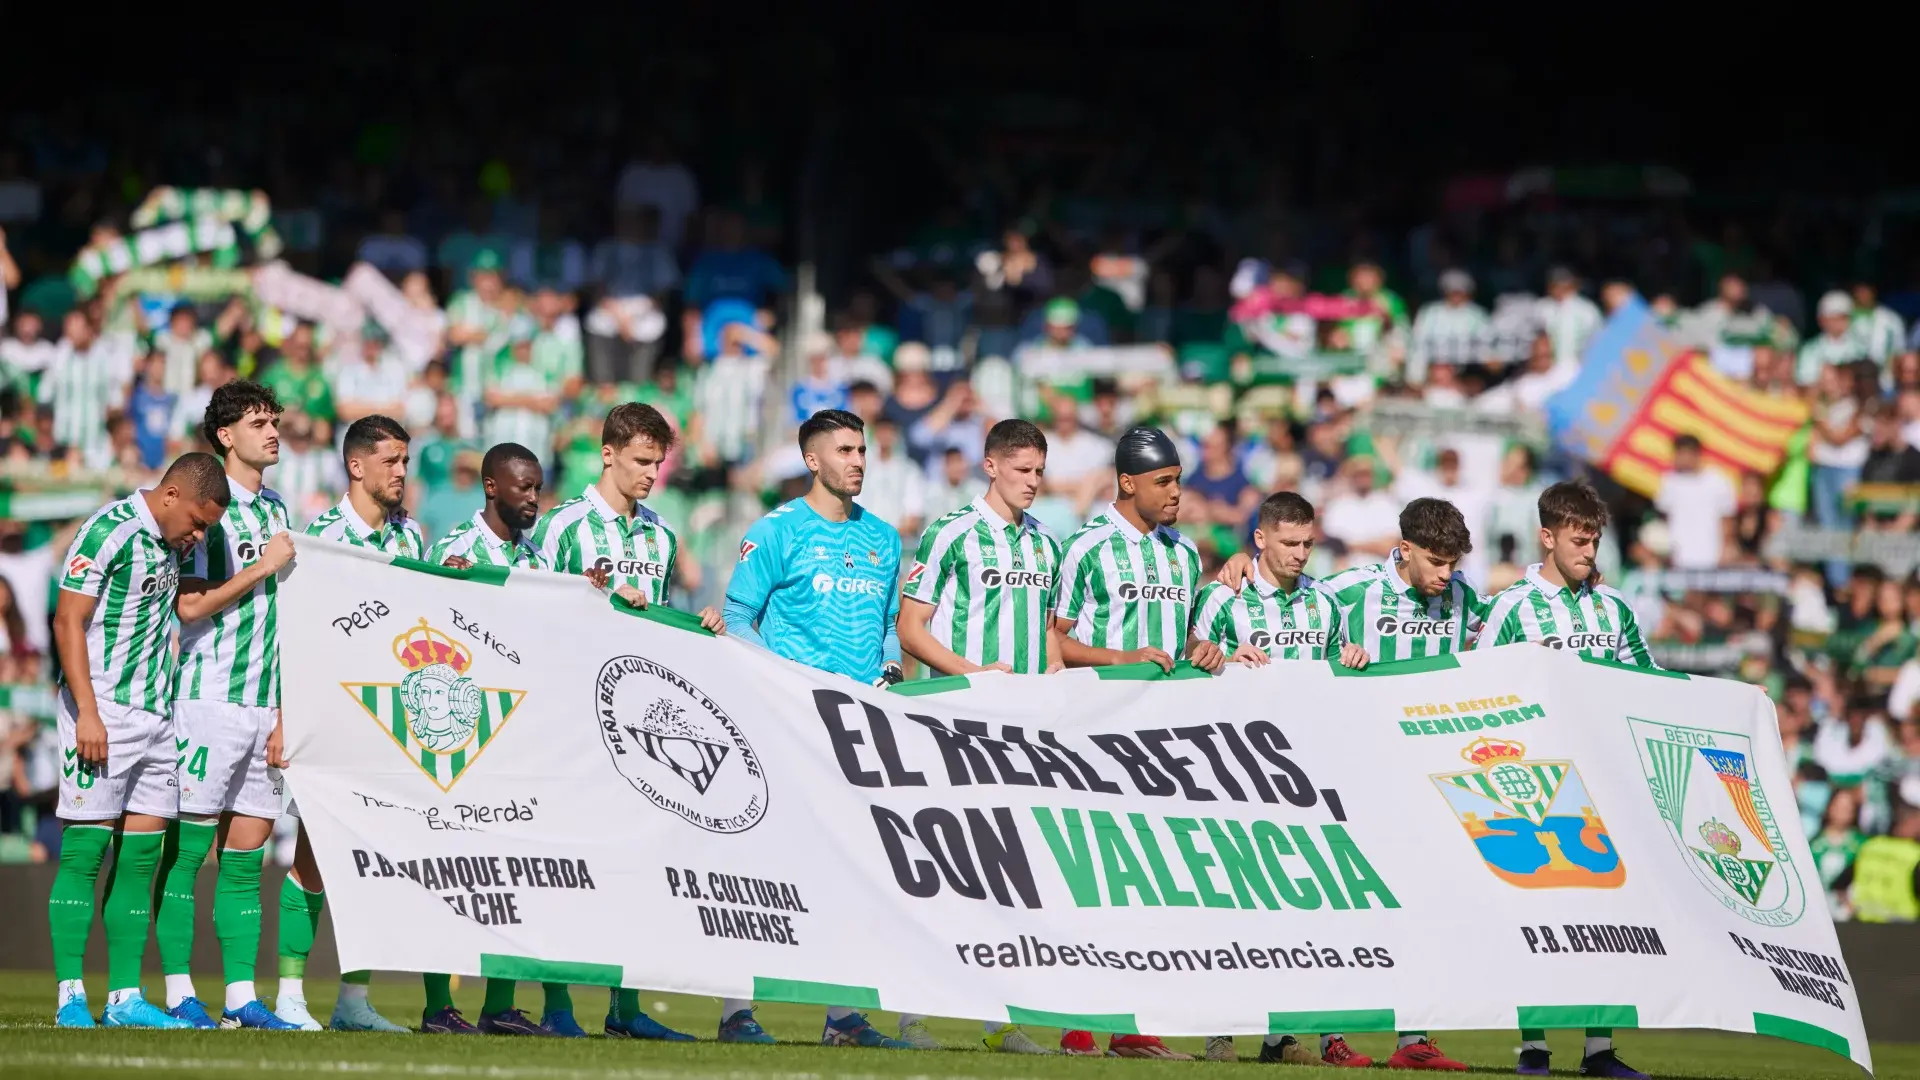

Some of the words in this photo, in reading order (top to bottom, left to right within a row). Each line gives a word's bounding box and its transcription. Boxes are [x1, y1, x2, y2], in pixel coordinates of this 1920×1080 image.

[157, 569, 179, 589] GRE
[617, 560, 664, 578] GREE
[1005, 571, 1052, 588] GREE
[836, 577, 886, 600] GREE
[1141, 585, 1186, 602] GREE
[332, 600, 390, 637] Peña
[449, 607, 521, 665] Bética
[1274, 631, 1325, 645] GREE
[1401, 621, 1455, 635] GREE
[1567, 634, 1616, 648] GREE
[623, 658, 698, 700] CULTURAL
[701, 698, 760, 779] DIANENSE
[1398, 703, 1546, 736] BENIDORM
[811, 689, 926, 788] EL
[904, 712, 1125, 795] REAL
[1088, 720, 1348, 822] BETIS,
[1750, 777, 1788, 862] CULTURAL
[505, 856, 596, 890] PIERDA
[870, 804, 1043, 909] CON
[1030, 806, 1402, 911] VALENCIA
[708, 872, 810, 913] CULTURAL
[697, 905, 799, 946] DIANENSE
[1520, 926, 1569, 954] P.B.
[1563, 924, 1667, 956] BENIDORM
[956, 935, 1395, 973] realbetisconvalencia.es
[1761, 942, 1849, 986] CULTURAL
[1768, 965, 1846, 1011] MANISES
